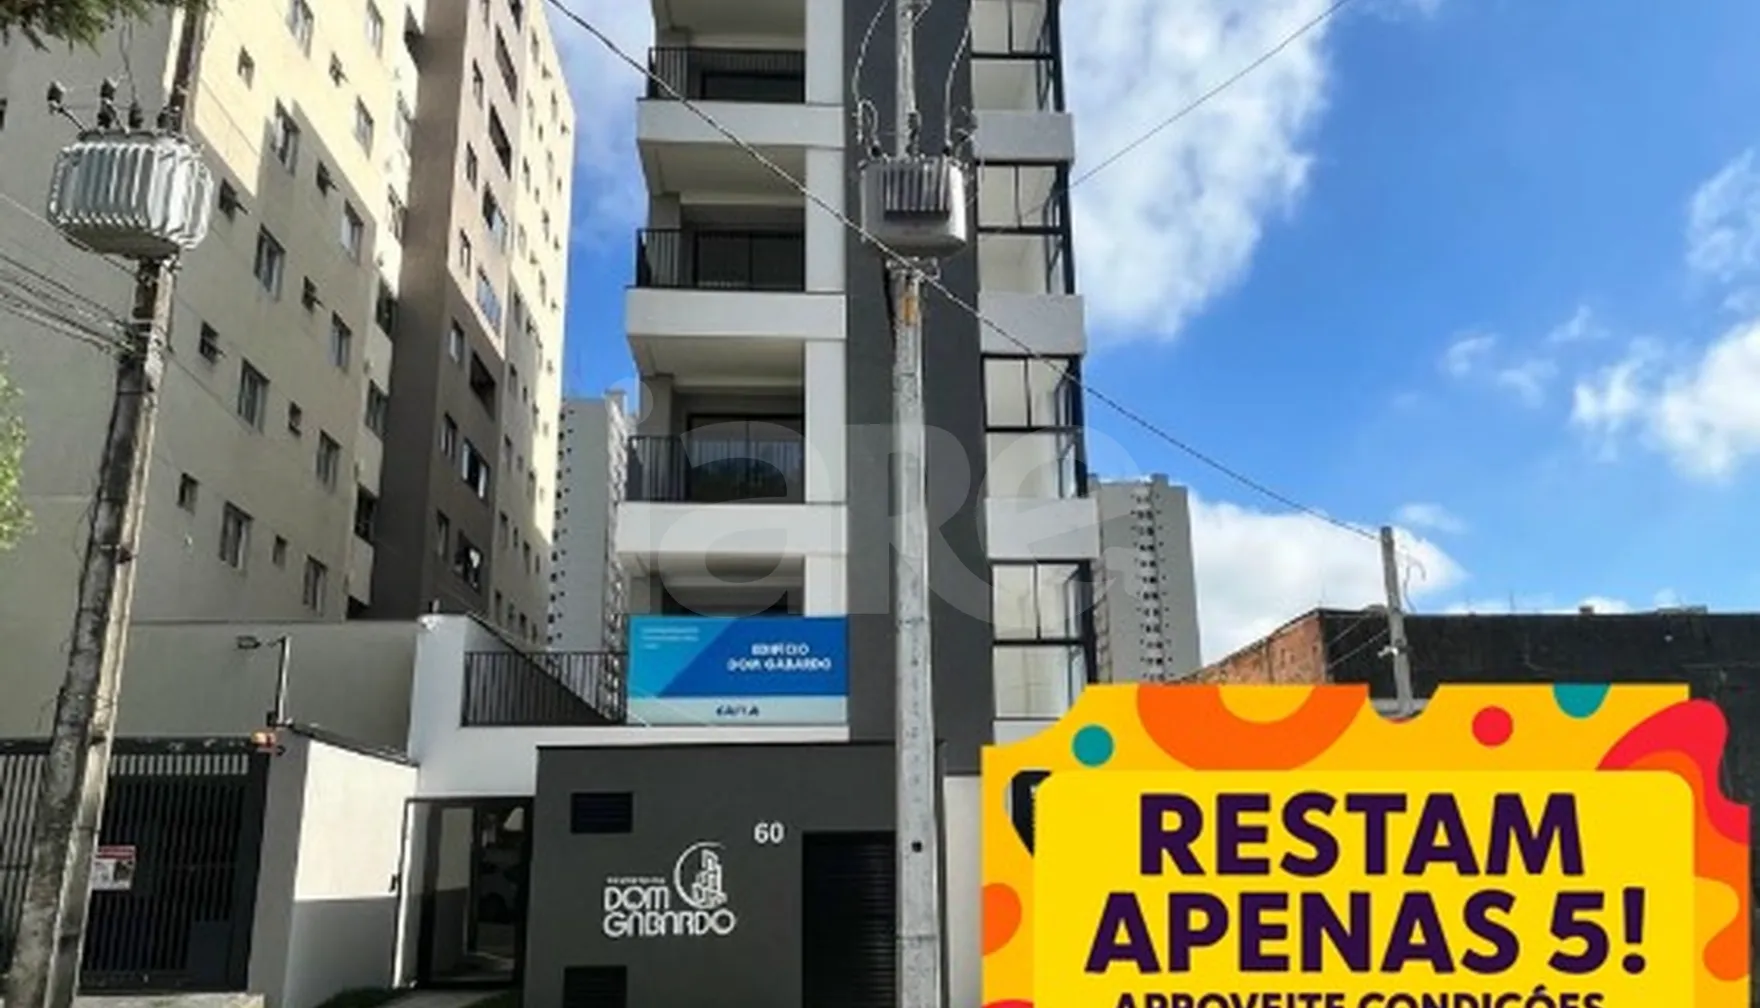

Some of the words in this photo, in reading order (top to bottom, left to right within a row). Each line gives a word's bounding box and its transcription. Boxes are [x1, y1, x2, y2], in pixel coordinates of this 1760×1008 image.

[754, 822, 784, 844] 60
[604, 886, 670, 911] DOM
[603, 908, 737, 938] GABARDO
